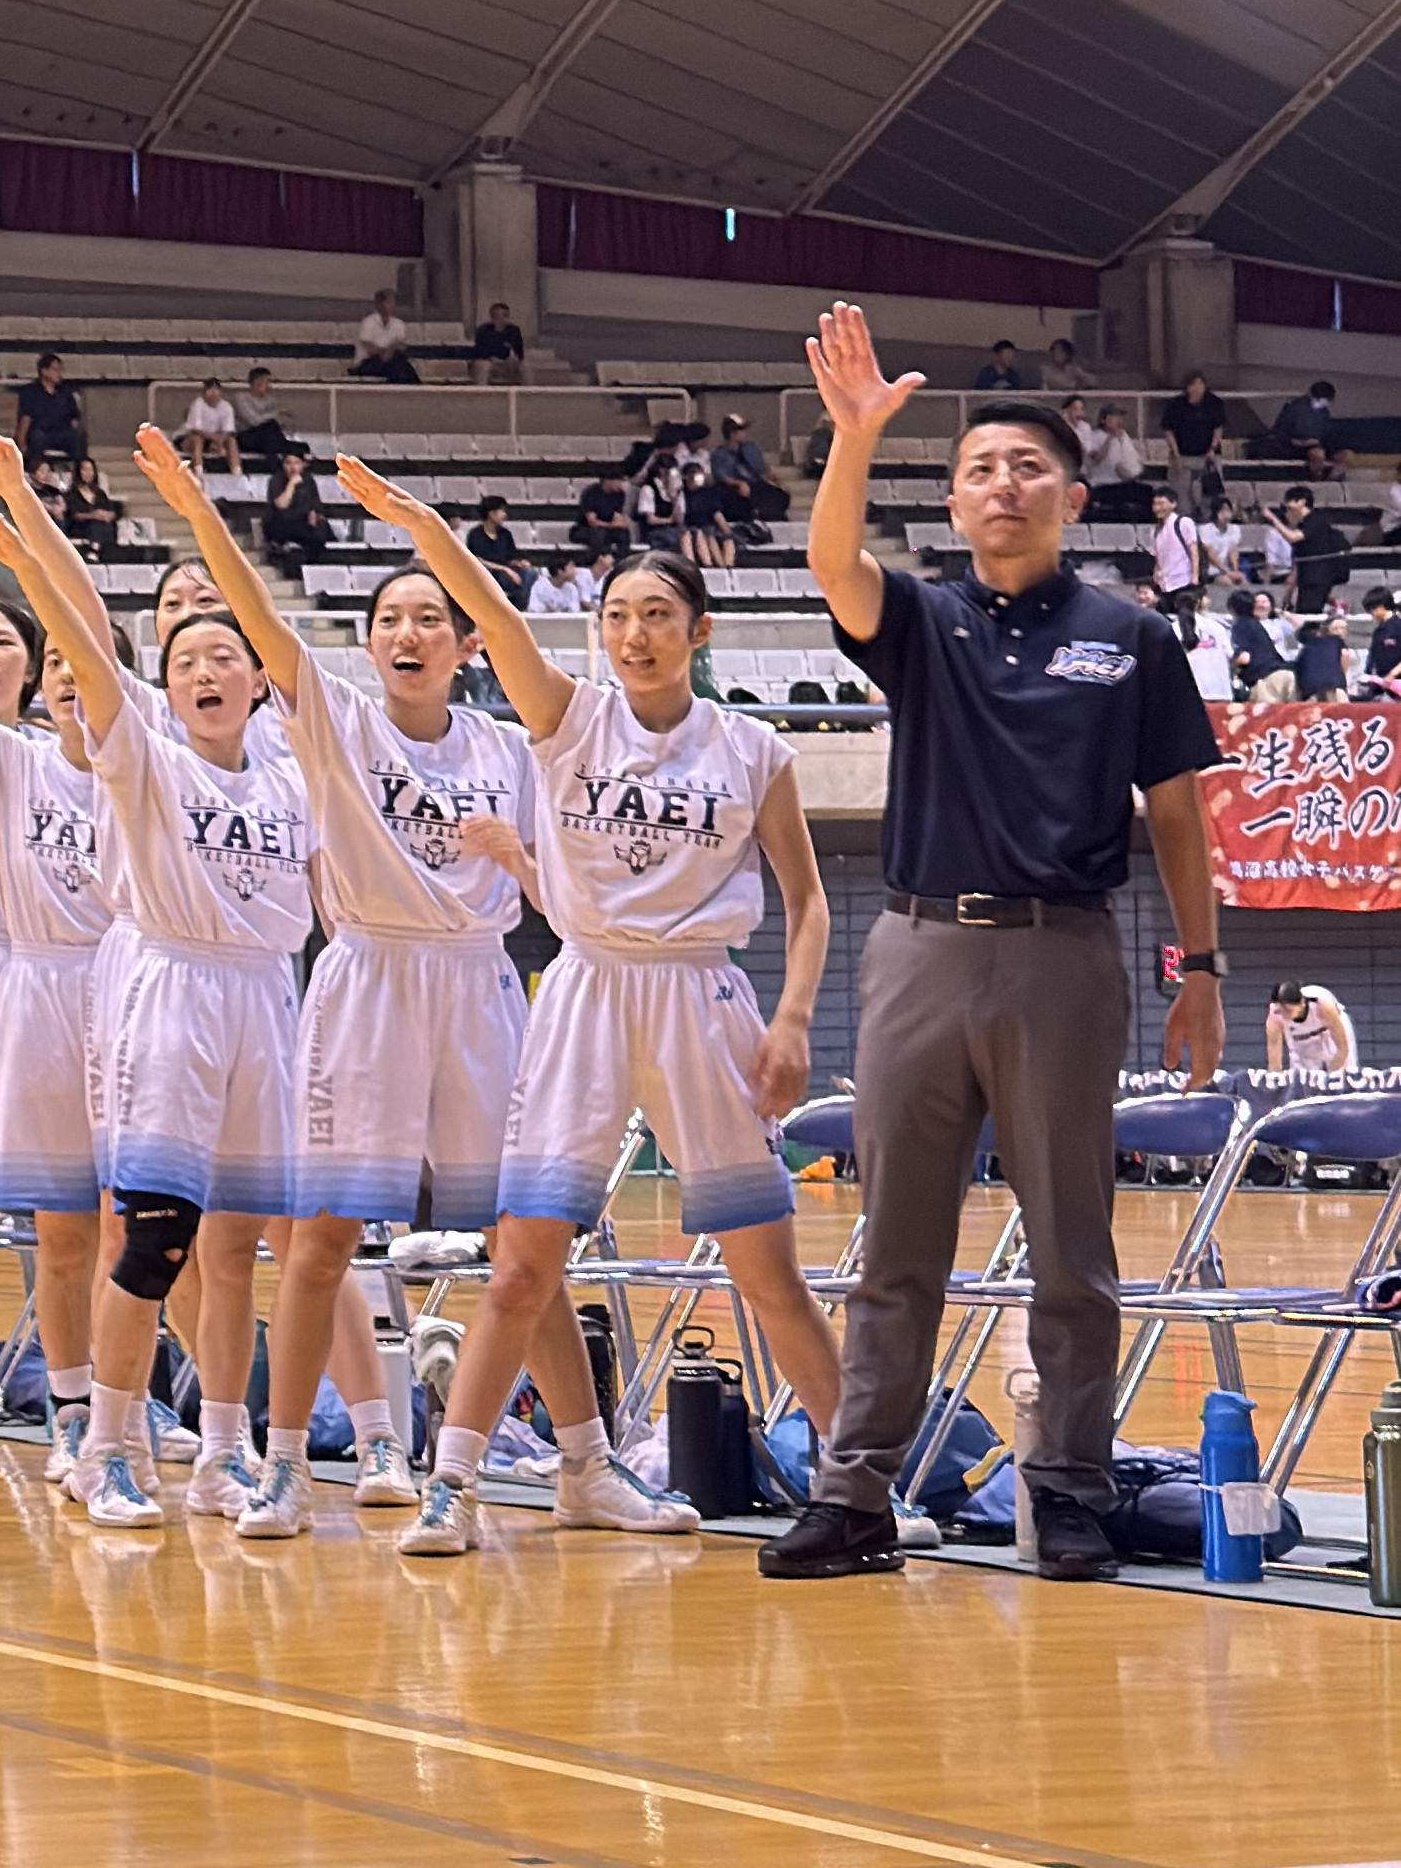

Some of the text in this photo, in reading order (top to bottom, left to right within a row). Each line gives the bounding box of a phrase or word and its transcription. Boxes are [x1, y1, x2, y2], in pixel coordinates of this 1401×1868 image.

[585, 781, 717, 831] YAEI
[187, 812, 297, 860] YAEI
[1163, 945, 1185, 981] 2
[308, 1075, 335, 1146] YAEI
